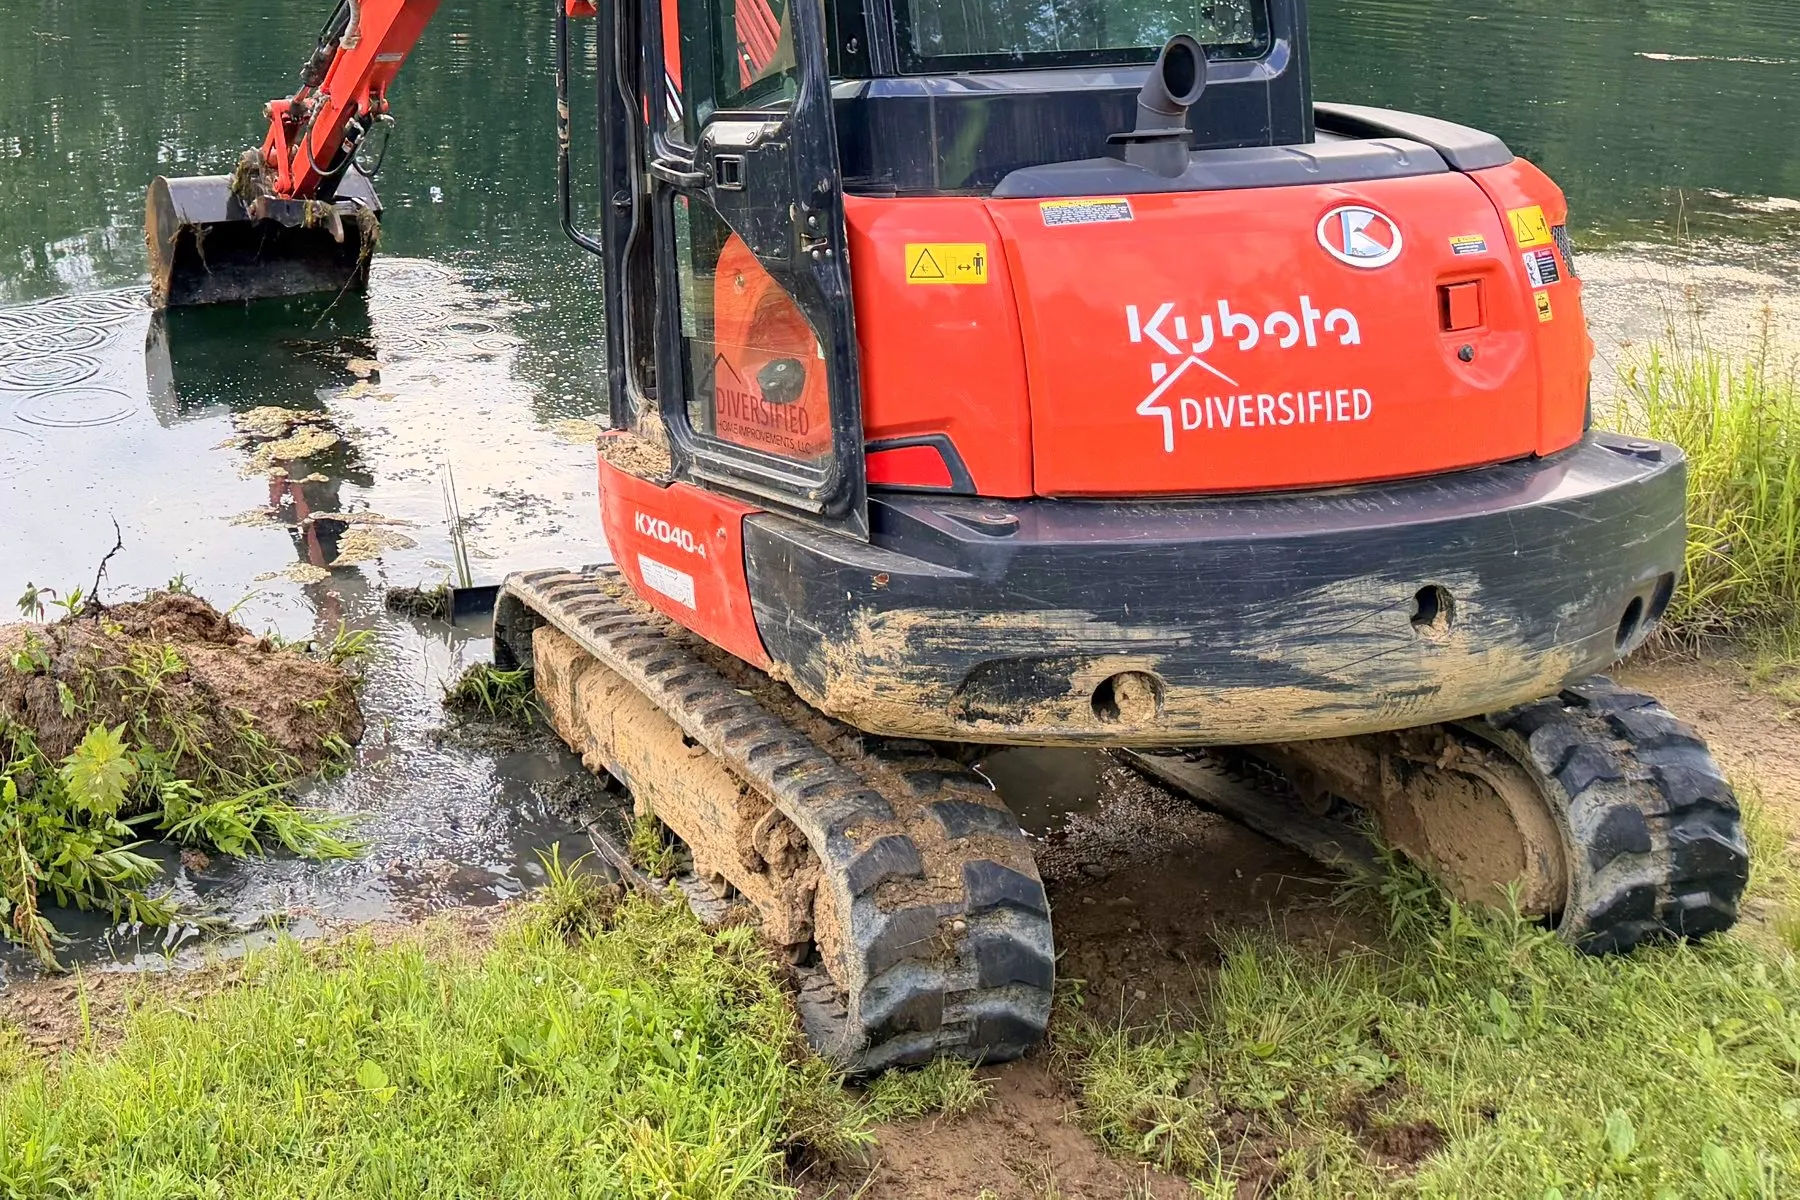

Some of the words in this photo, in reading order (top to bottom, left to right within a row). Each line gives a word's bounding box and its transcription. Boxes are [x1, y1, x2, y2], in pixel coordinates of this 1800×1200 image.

[1126, 295, 1361, 355] Kubota
[716, 387, 809, 436] DIVERSIFIED
[1180, 388, 1372, 431] DIVERSIFIED
[718, 420, 738, 435] HOME
[797, 439, 812, 455] LLC
[635, 510, 707, 560] KX040-4
